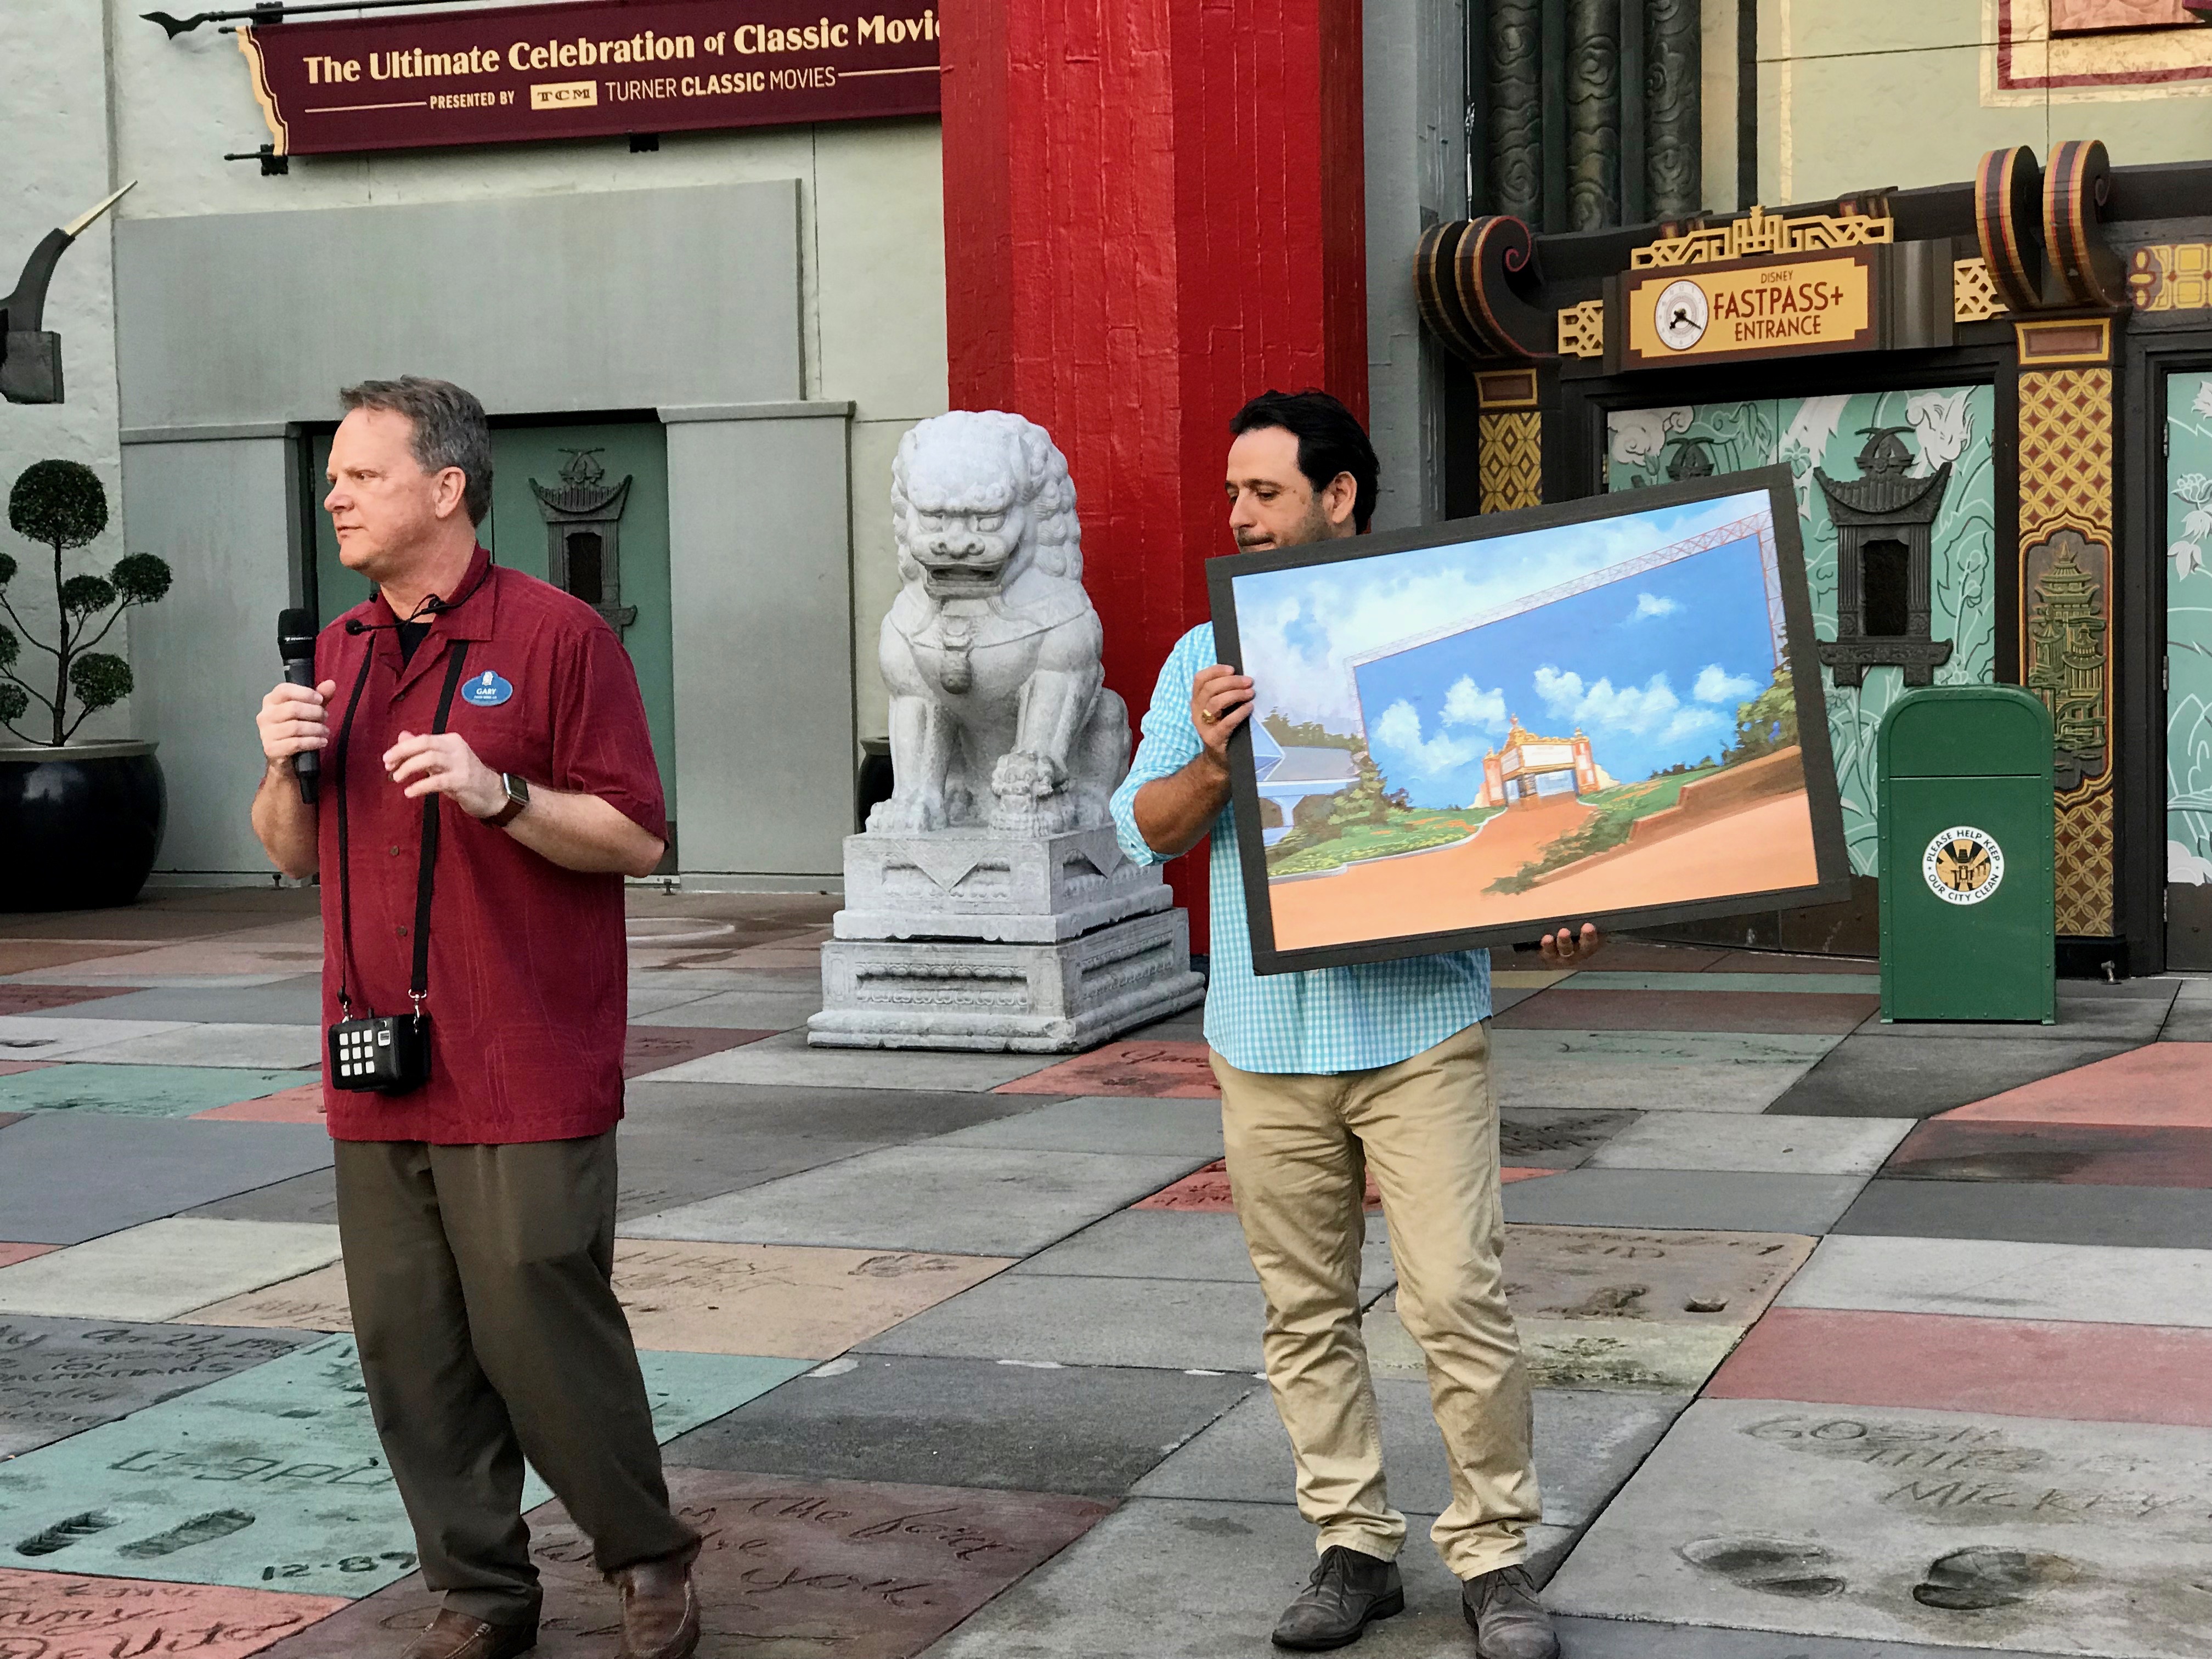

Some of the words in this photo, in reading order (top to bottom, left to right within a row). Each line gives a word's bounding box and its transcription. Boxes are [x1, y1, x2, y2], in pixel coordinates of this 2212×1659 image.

[303, 55, 361, 84] The
[370, 45, 500, 80] Ultimate
[508, 30, 695, 71] Celebration
[704, 31, 726, 55] of
[733, 16, 849, 55] Classic
[857, 9, 940, 46] Movi
[430, 91, 495, 109] PRESENTED
[500, 90, 515, 105] BY
[537, 87, 592, 103] TCM
[605, 78, 677, 102] TURNER
[681, 71, 765, 97] CLASSIC
[770, 66, 836, 90] MOVIES
[1760, 269, 1794, 284] DISNEY
[1713, 281, 1844, 321] FASTPASS+
[1734, 314, 1822, 342] ENTRANCE
[1926, 832, 1953, 862] PLEASE
[1956, 830, 1982, 839] HELP
[1983, 839, 2000, 861] KEEP
[1928, 874, 1945, 895] OUR
[1948, 892, 1971, 901] CITY
[1974, 874, 1999, 899] CLEAN
